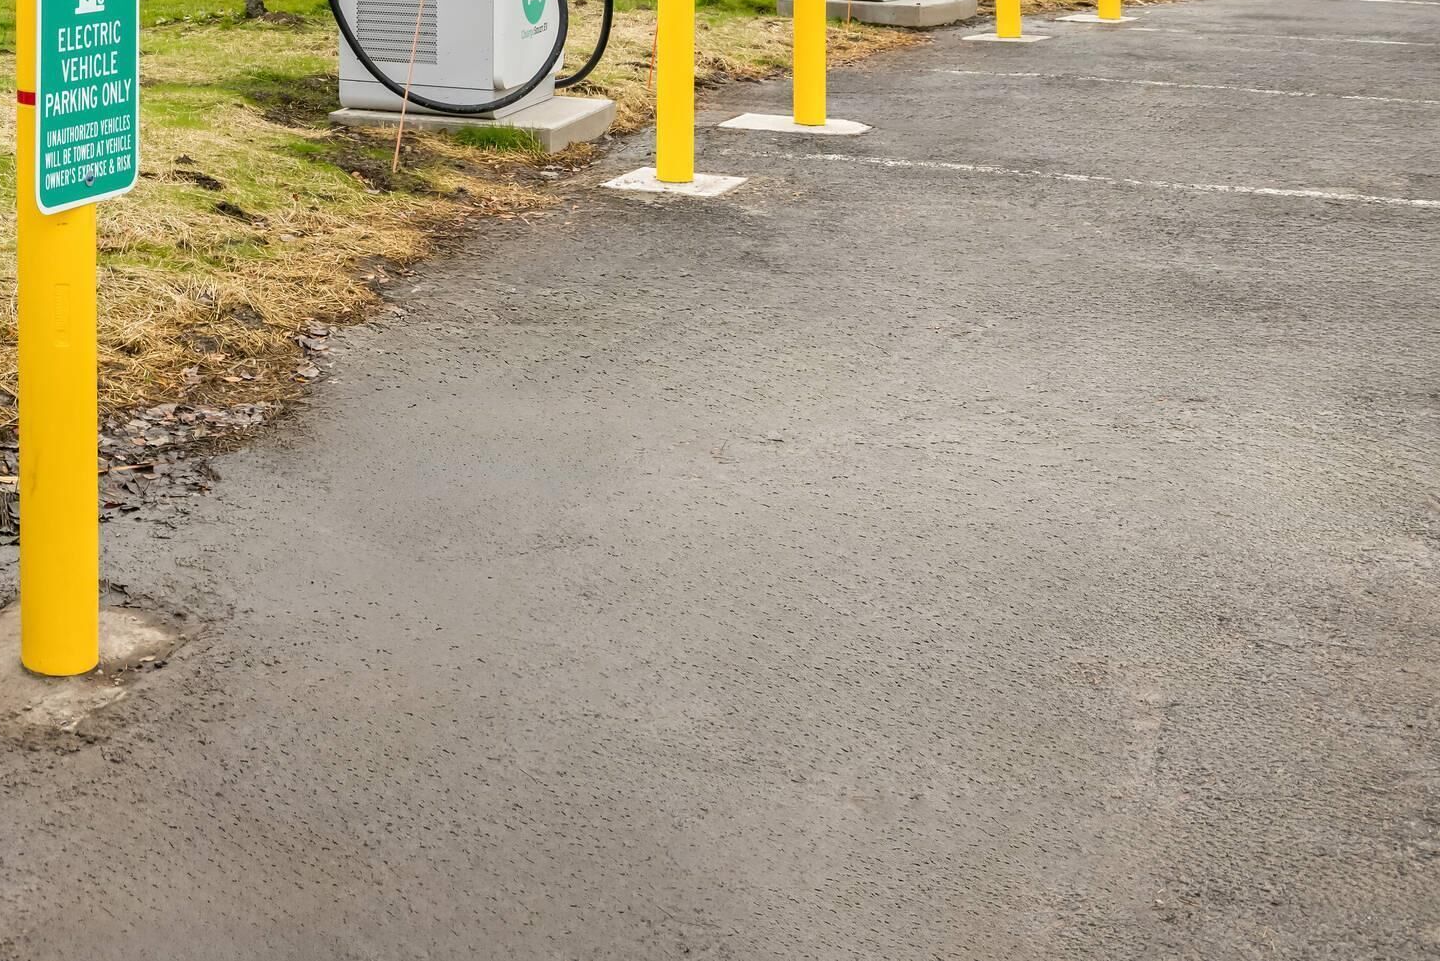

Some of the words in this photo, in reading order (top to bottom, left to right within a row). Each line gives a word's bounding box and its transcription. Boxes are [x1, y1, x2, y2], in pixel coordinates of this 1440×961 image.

[58, 20, 121, 53] ELECTRIC
[61, 50, 118, 83] VEHICLE
[45, 85, 98, 118] PARKING
[102, 78, 132, 106] ONLY
[46, 121, 99, 148] UNAUTHORIZED
[100, 114, 131, 136] VEHICLES
[45, 150, 61, 169] WILL
[63, 147, 72, 165] BE
[73, 142, 95, 164] TOWED
[96, 140, 105, 157] AT
[105, 134, 131, 155] VEHICLE
[45, 167, 76, 190] OWNER'S
[109, 158, 114, 174] &
[116, 154, 131, 172] RISK
